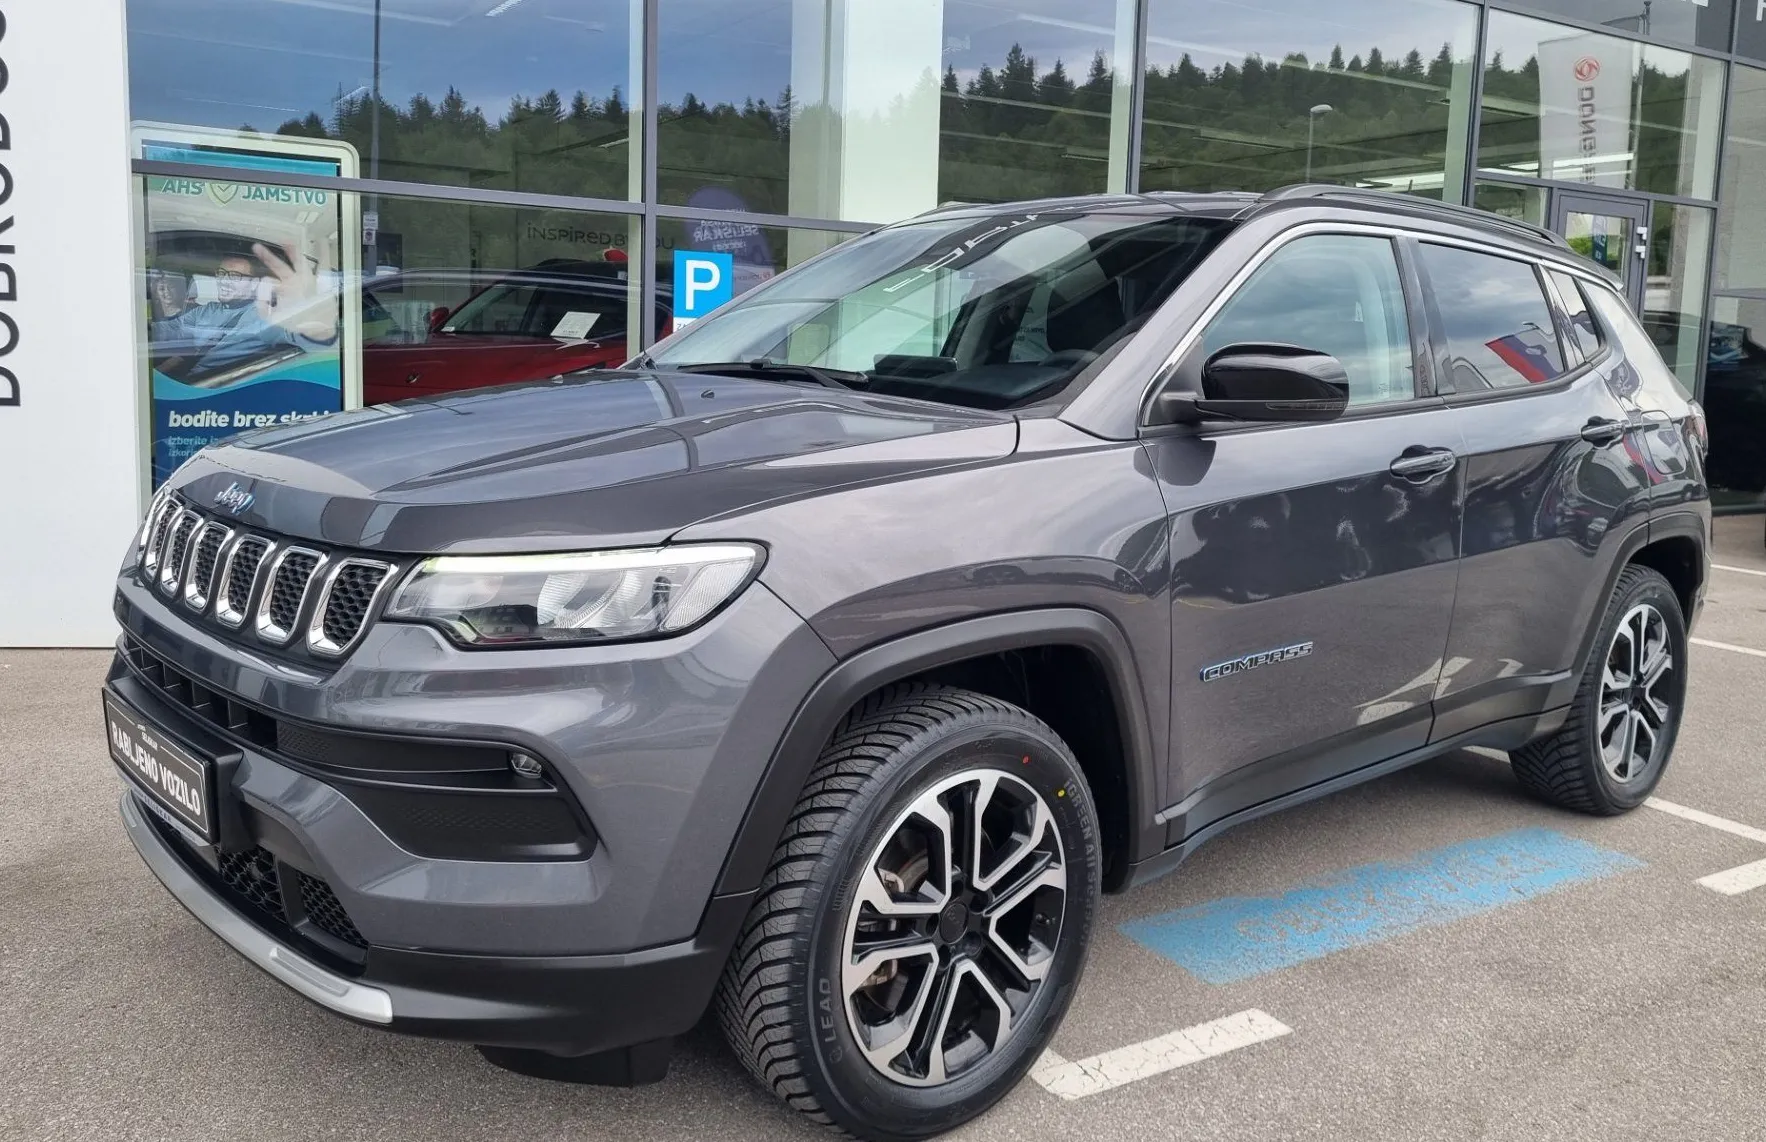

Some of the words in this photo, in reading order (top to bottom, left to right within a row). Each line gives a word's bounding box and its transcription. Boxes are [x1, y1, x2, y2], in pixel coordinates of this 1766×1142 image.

[242, 184, 328, 206] JAMSTVO
[685, 260, 721, 310] P
[168, 409, 230, 428] bodite
[233, 410, 277, 428] brez
[1199, 641, 1314, 682] COMPASS
[111, 720, 159, 784] RABLJENO
[158, 762, 201, 816] VOZILO
